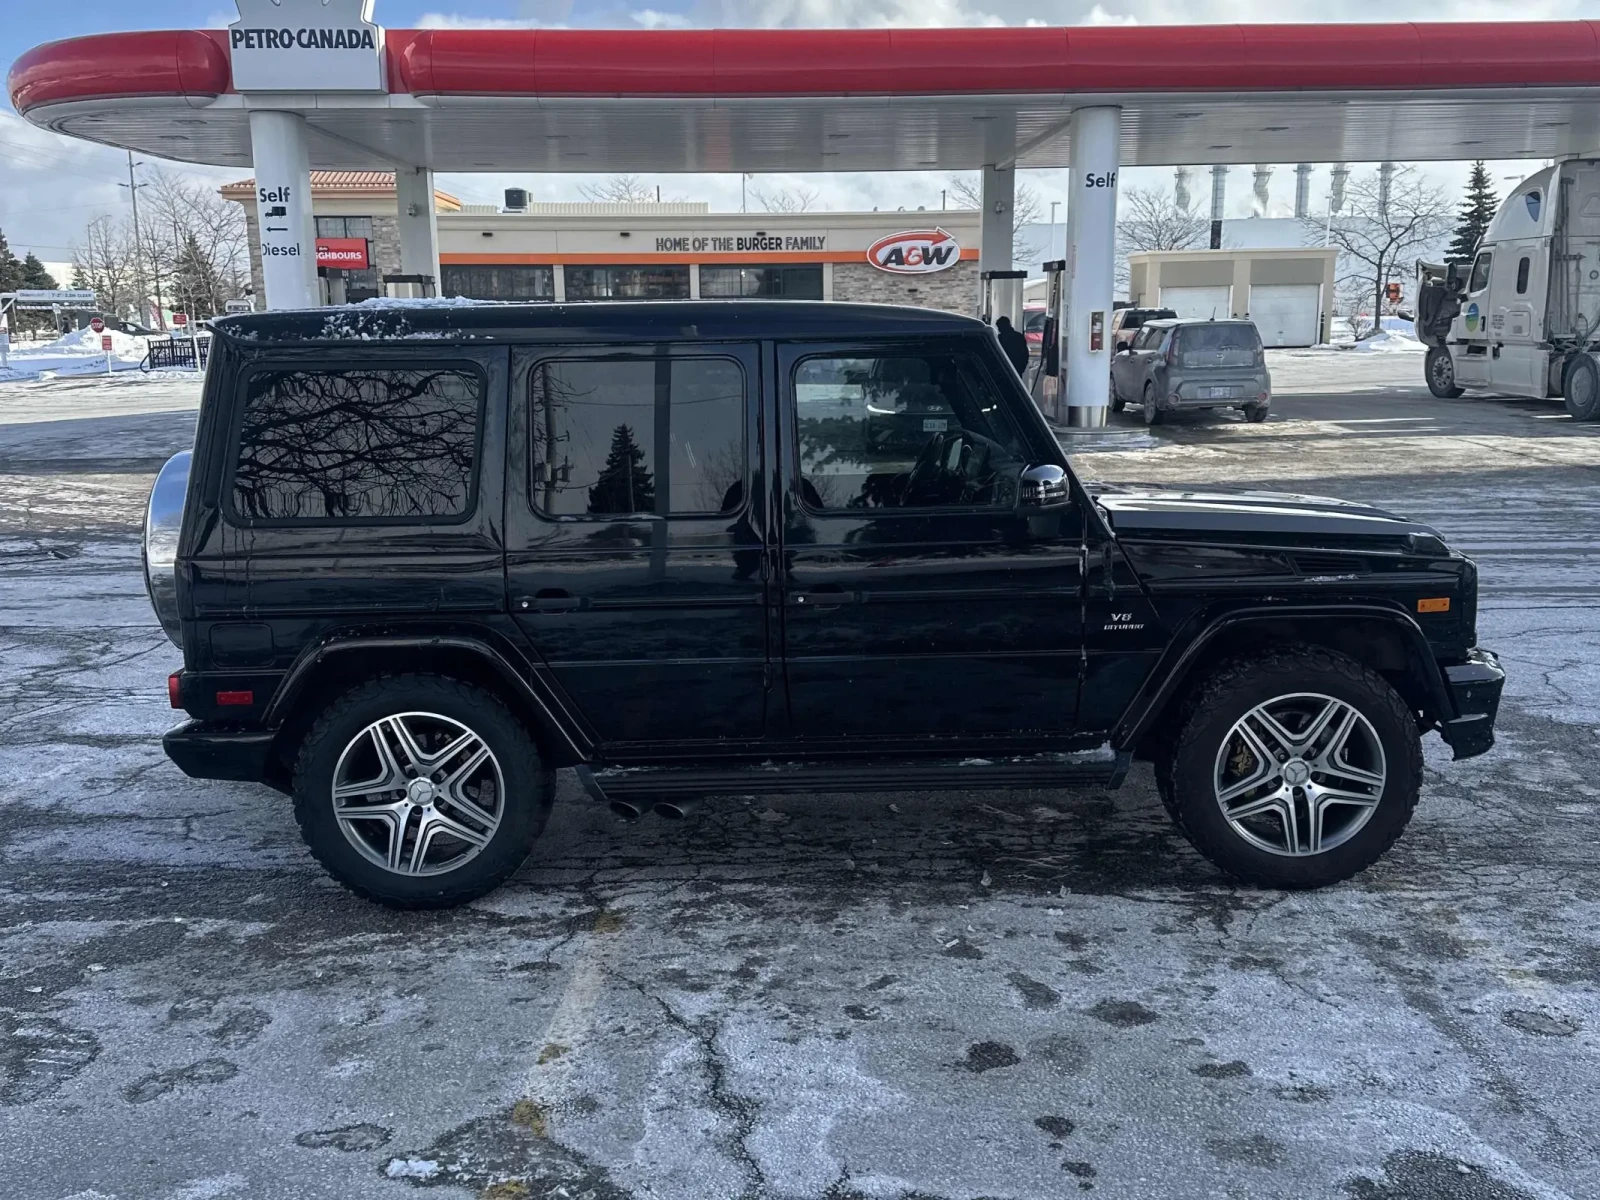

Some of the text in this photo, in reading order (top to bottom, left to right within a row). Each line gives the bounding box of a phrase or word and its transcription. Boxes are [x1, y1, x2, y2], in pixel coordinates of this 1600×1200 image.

[1085, 171, 1116, 188] Self
[259, 186, 291, 203] Self
[261, 242, 301, 256] Diesel
[655, 236, 826, 251] HOME OF THE BURGER FAMILY
[880, 245, 955, 266] A&W
[1110, 612, 1133, 622] V8
